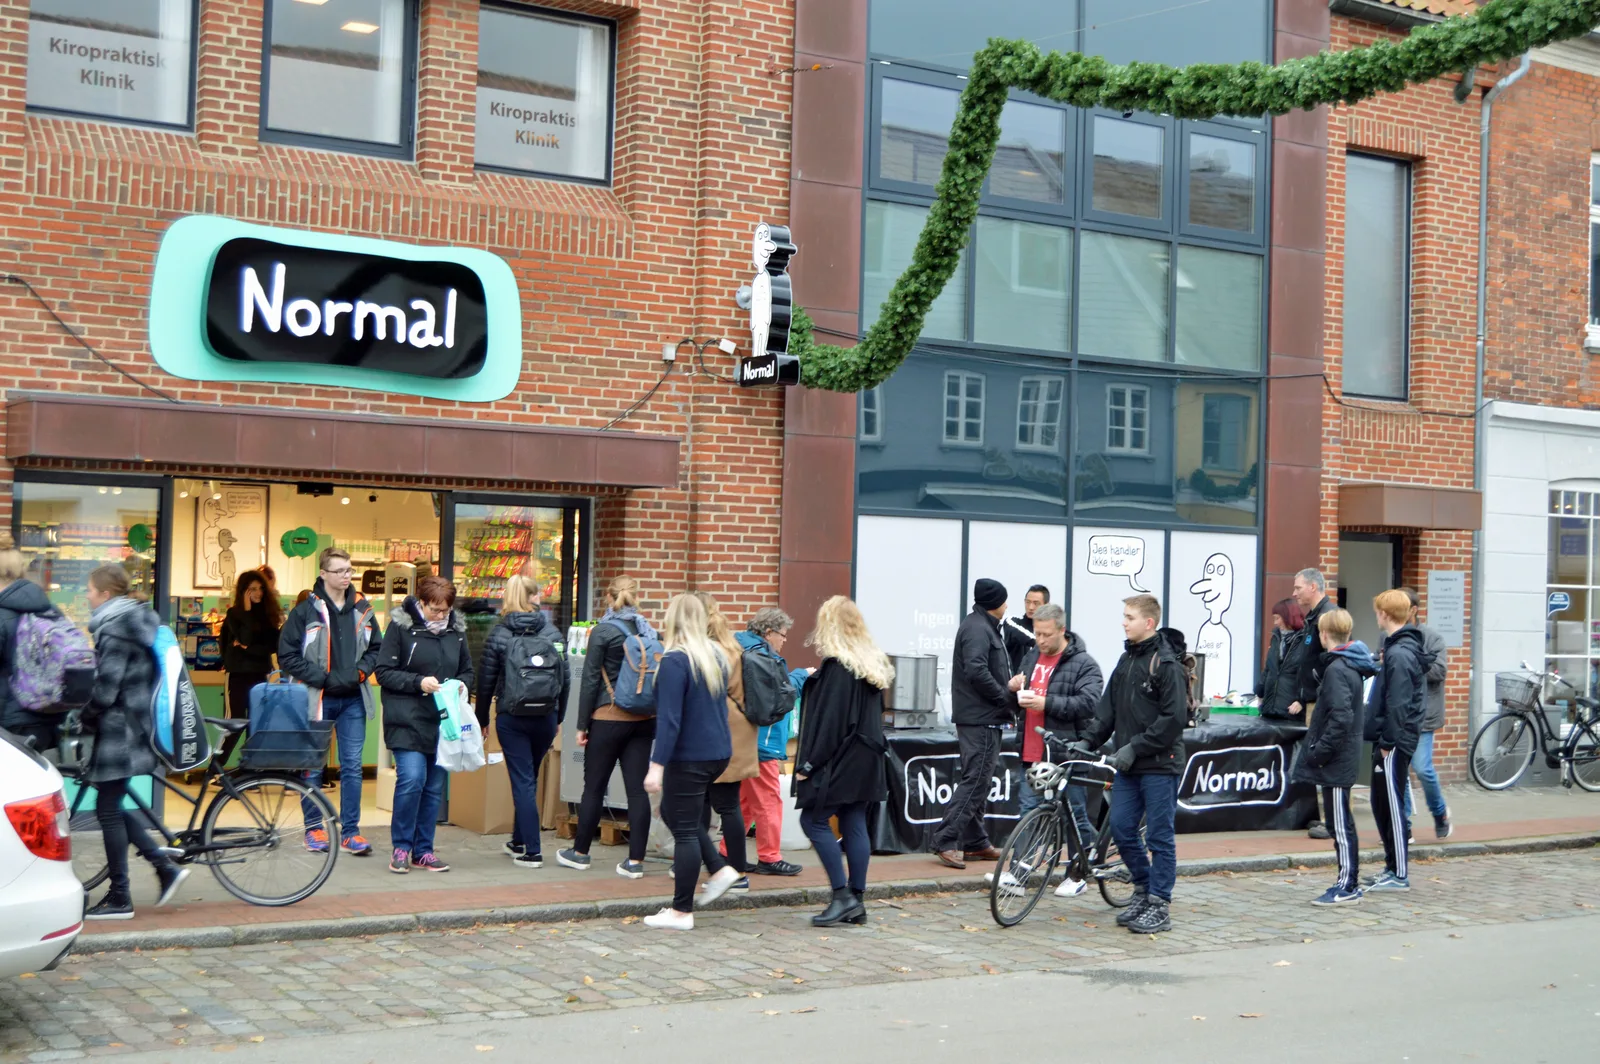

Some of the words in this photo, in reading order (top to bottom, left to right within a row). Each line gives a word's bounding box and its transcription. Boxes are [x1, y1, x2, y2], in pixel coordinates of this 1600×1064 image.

[49, 36, 167, 69] Kiropraktisk
[80, 68, 135, 91] Klinik
[490, 101, 576, 128] Kiropraktis
[514, 128, 560, 149] Klinik
[242, 262, 458, 349] Normal
[743, 359, 775, 381] Normal
[1092, 543, 1108, 555] Jeg
[1110, 543, 1141, 556] handler
[1092, 556, 1108, 567] ikke
[1110, 556, 1125, 568] her
[914, 608, 955, 629] Ingen
[917, 767, 1011, 806] Noal
[1192, 760, 1275, 794] Normal
